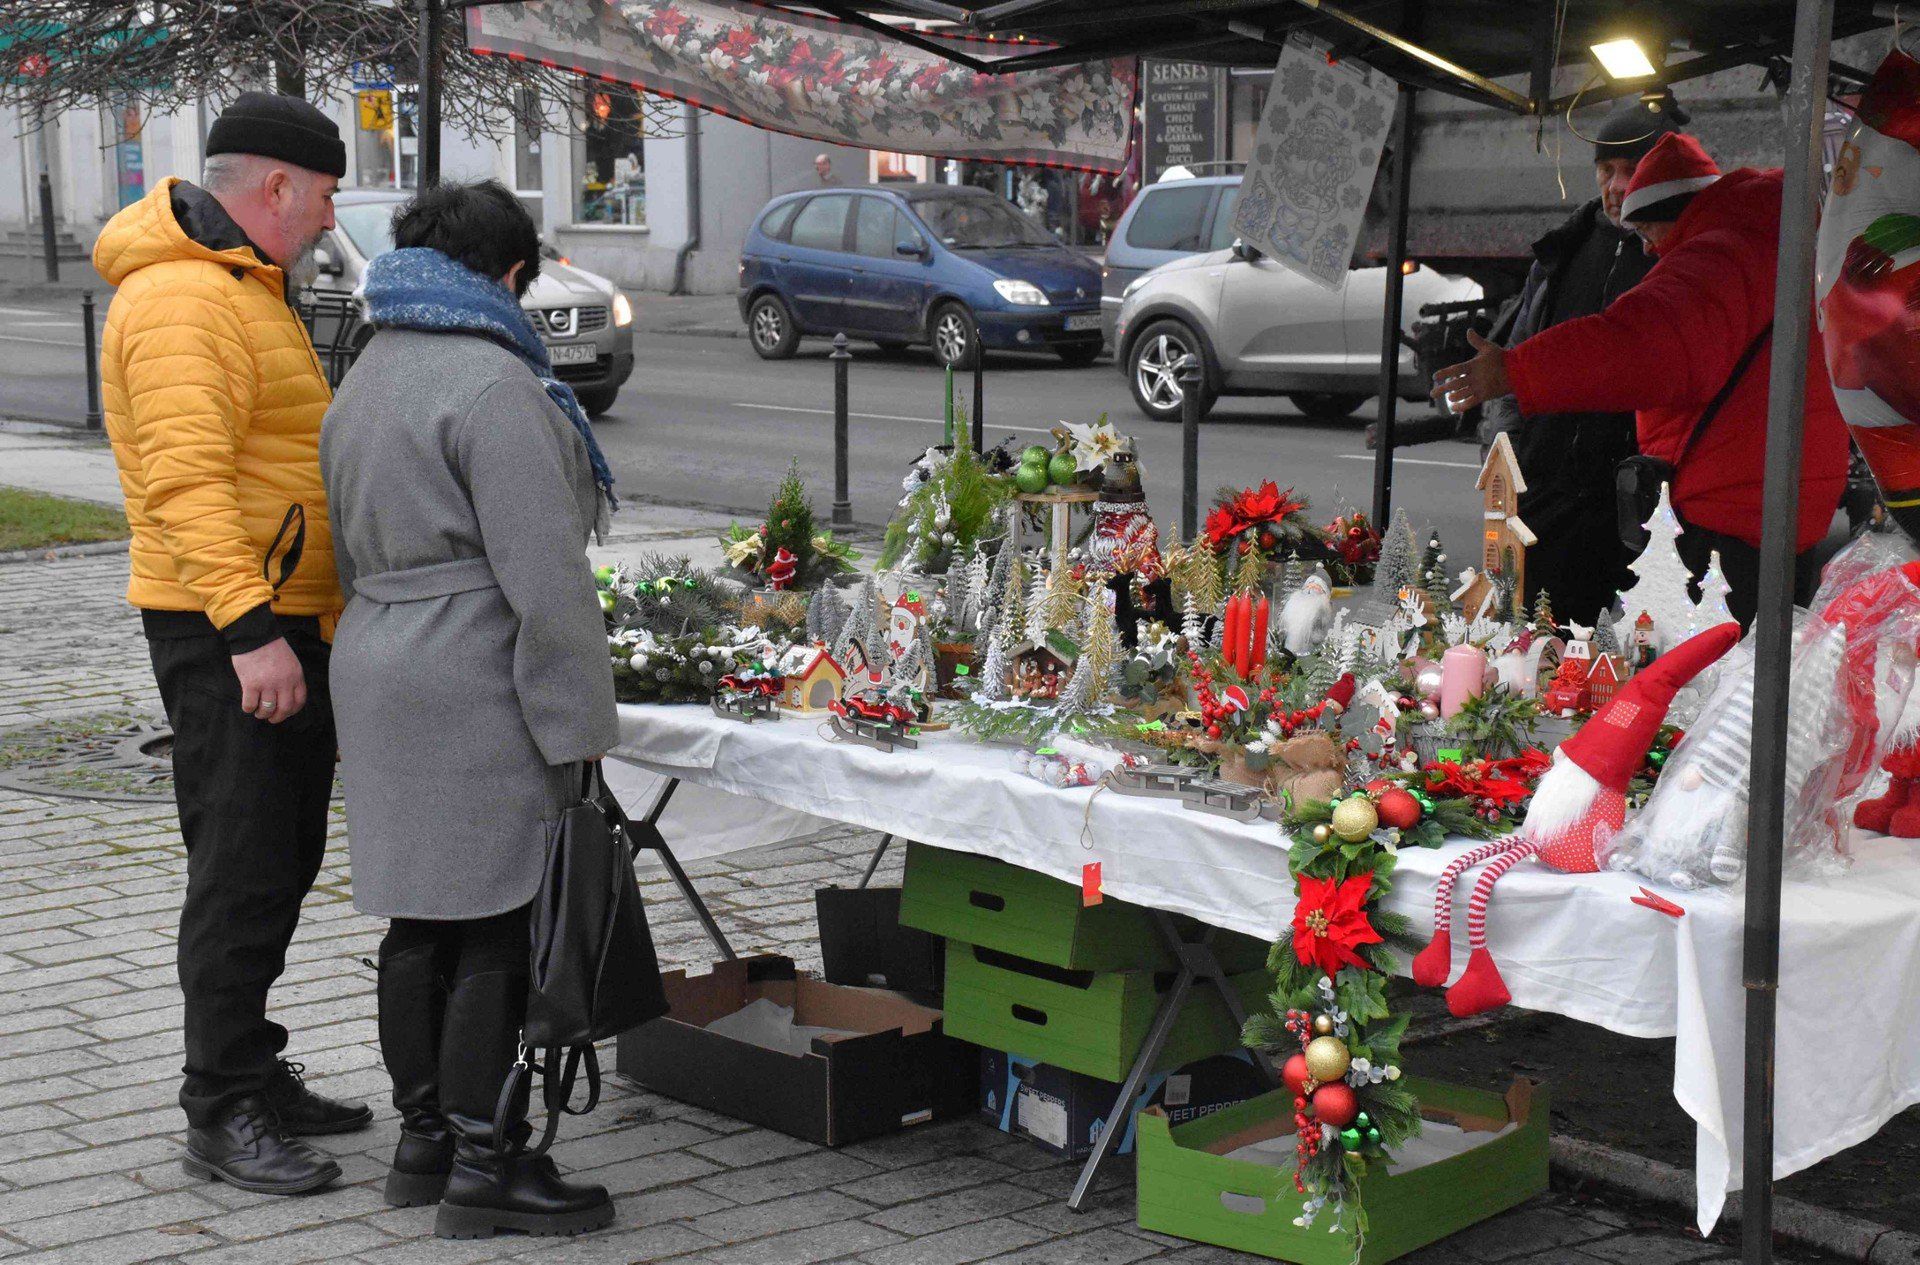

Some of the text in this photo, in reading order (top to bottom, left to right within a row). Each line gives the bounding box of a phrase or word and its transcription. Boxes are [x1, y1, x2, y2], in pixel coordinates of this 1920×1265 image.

[1153, 64, 1208, 80] SENSES
[1151, 92, 1183, 102] CALVIN
[1163, 103, 1197, 112] CHANEL
[1166, 124, 1194, 133] DOLCE
[1156, 134, 1163, 143] &
[1169, 144, 1191, 153] DIOR
[1166, 154, 1194, 164] GUCCI
